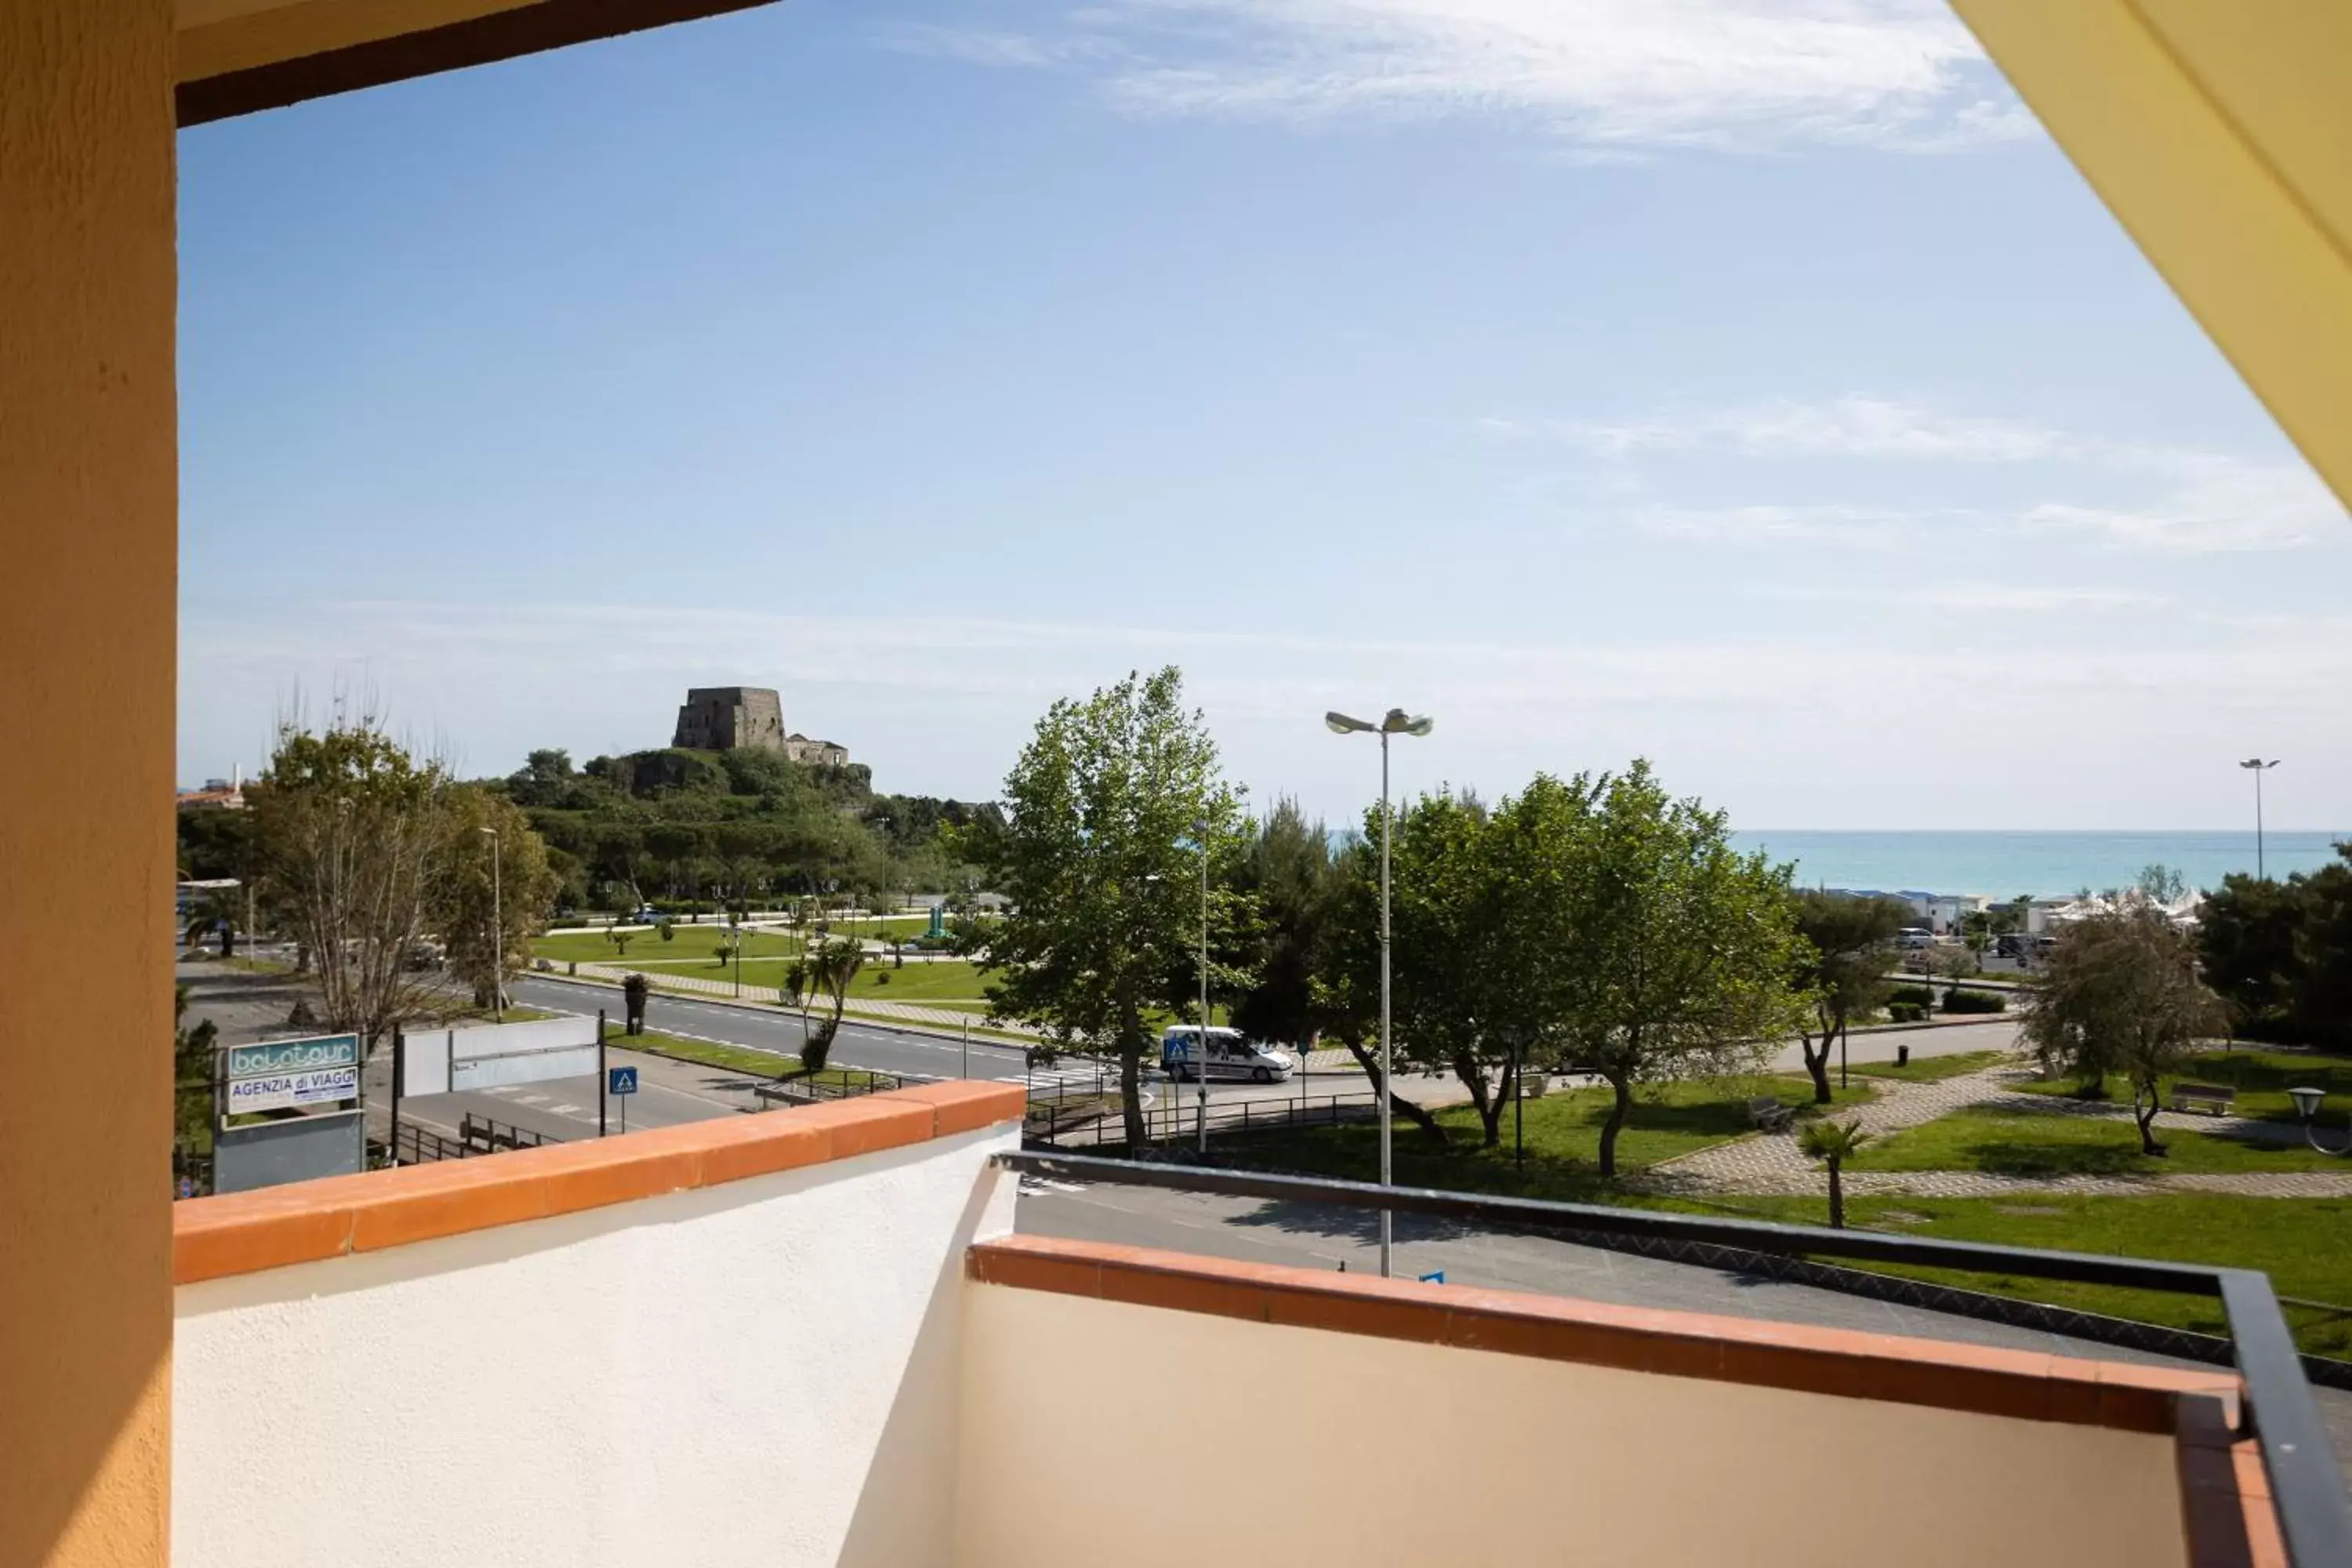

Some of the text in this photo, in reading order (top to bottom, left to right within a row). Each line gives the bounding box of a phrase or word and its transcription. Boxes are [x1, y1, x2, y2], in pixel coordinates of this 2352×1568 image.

[233, 1069, 356, 1096] AGENZIA di VIAGGI
